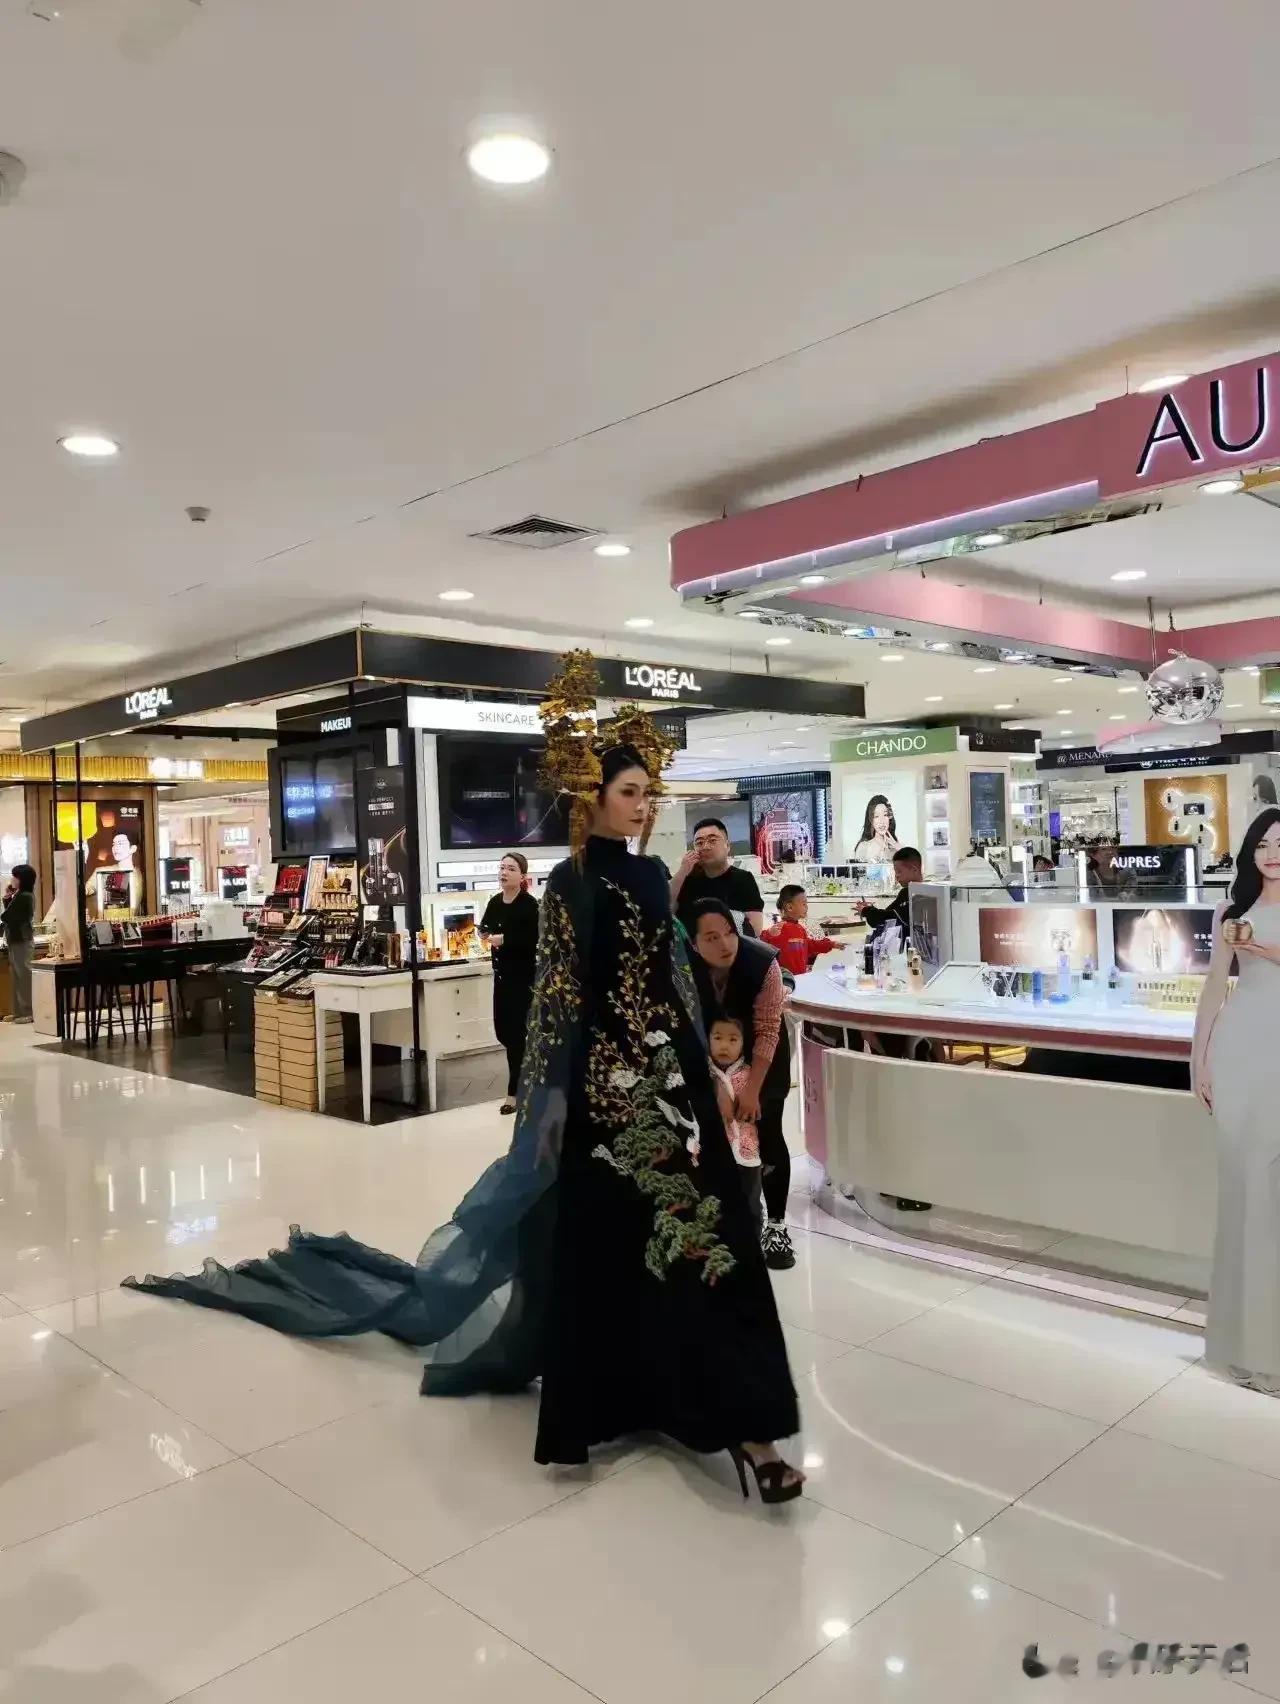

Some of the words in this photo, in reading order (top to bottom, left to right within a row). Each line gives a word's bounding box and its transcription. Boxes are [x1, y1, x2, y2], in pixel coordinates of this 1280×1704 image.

[1136, 367, 1268, 477] AU
[624, 664, 702, 692] L'ORÉAL
[651, 687, 680, 699] PARIS
[478, 711, 536, 726] SKINCARE
[856, 735, 927, 756] CHANDO
[1109, 855, 1161, 869] AUPRES
